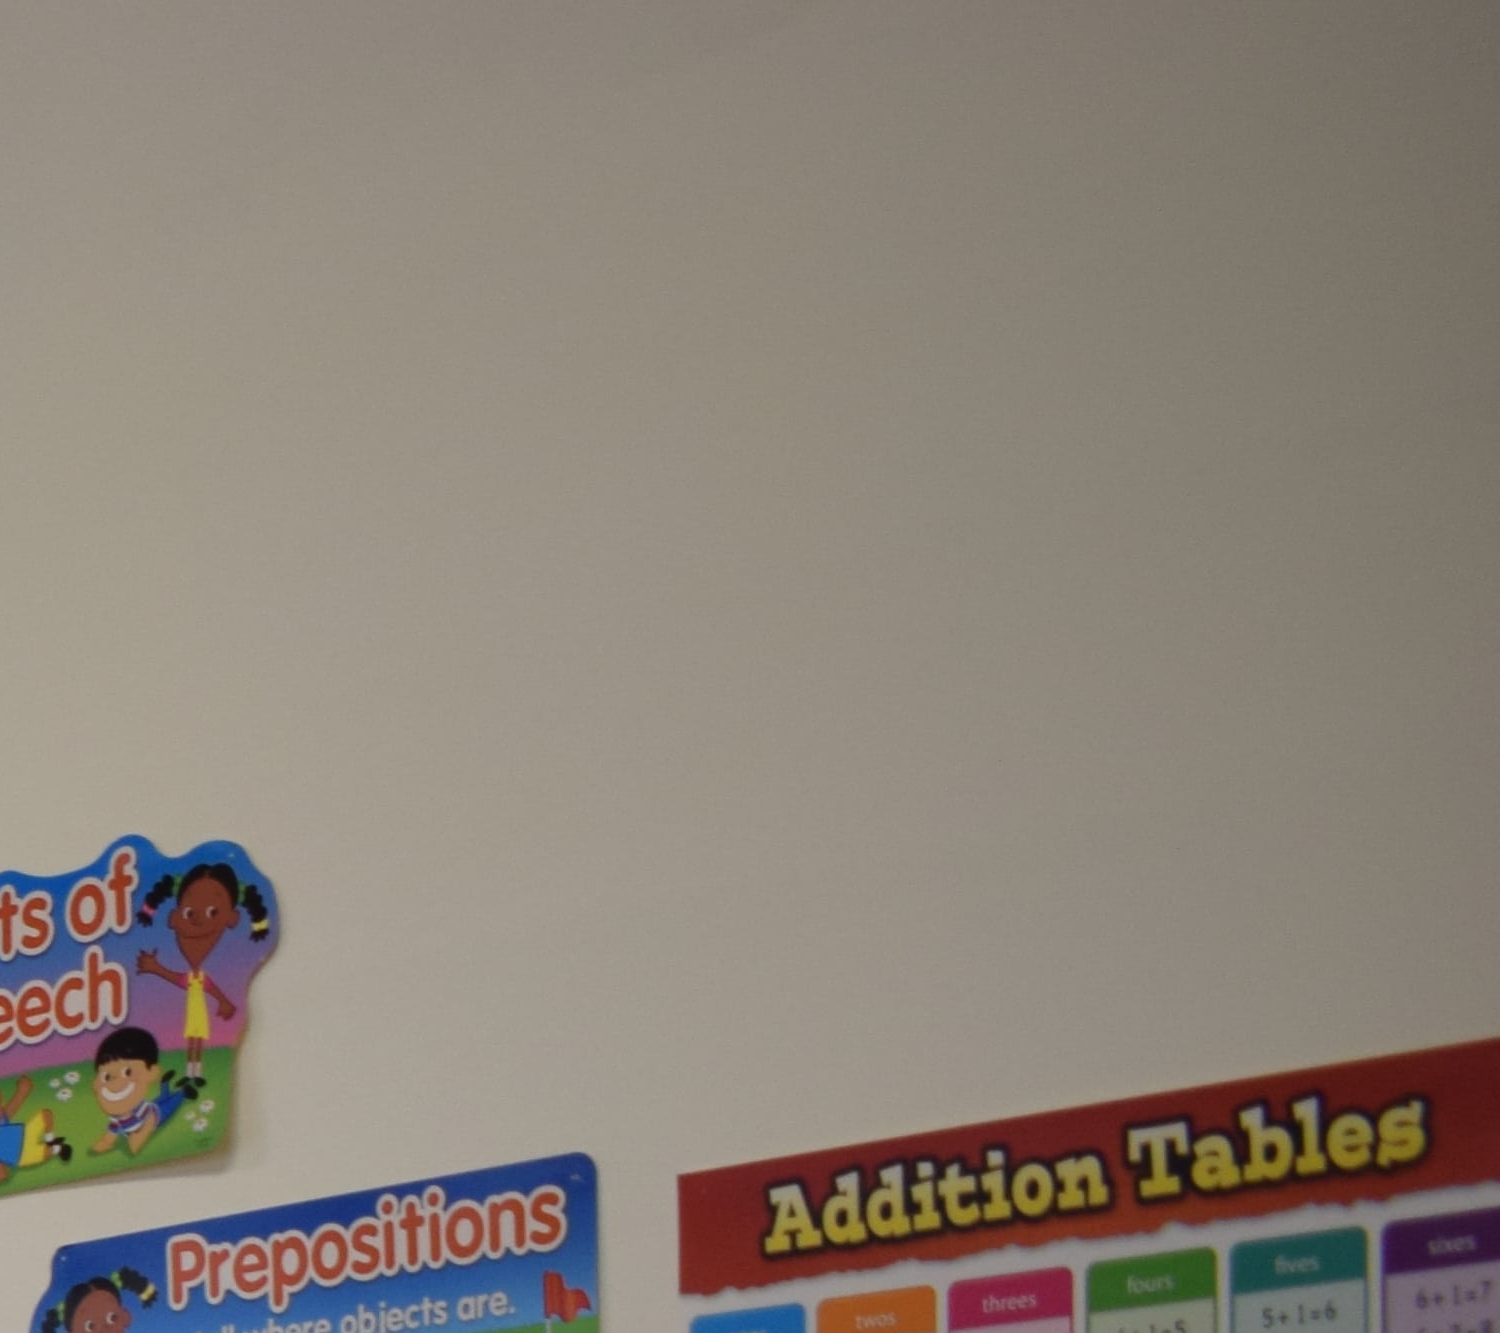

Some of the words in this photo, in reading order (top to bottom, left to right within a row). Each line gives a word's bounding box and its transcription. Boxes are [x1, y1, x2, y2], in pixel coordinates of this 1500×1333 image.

[67, 847, 136, 936] of
[763, 1143, 1109, 1258] Addition
[1127, 1093, 1428, 1201] Tables
[168, 1185, 566, 1311] Prepositions
[1427, 1231, 1477, 1256] sixes
[1274, 1252, 1319, 1276] fives
[1127, 1272, 1175, 1295] fours
[457, 1291, 515, 1321] are.
[982, 1288, 1037, 1313] threes
[855, 1309, 896, 1331] twos
